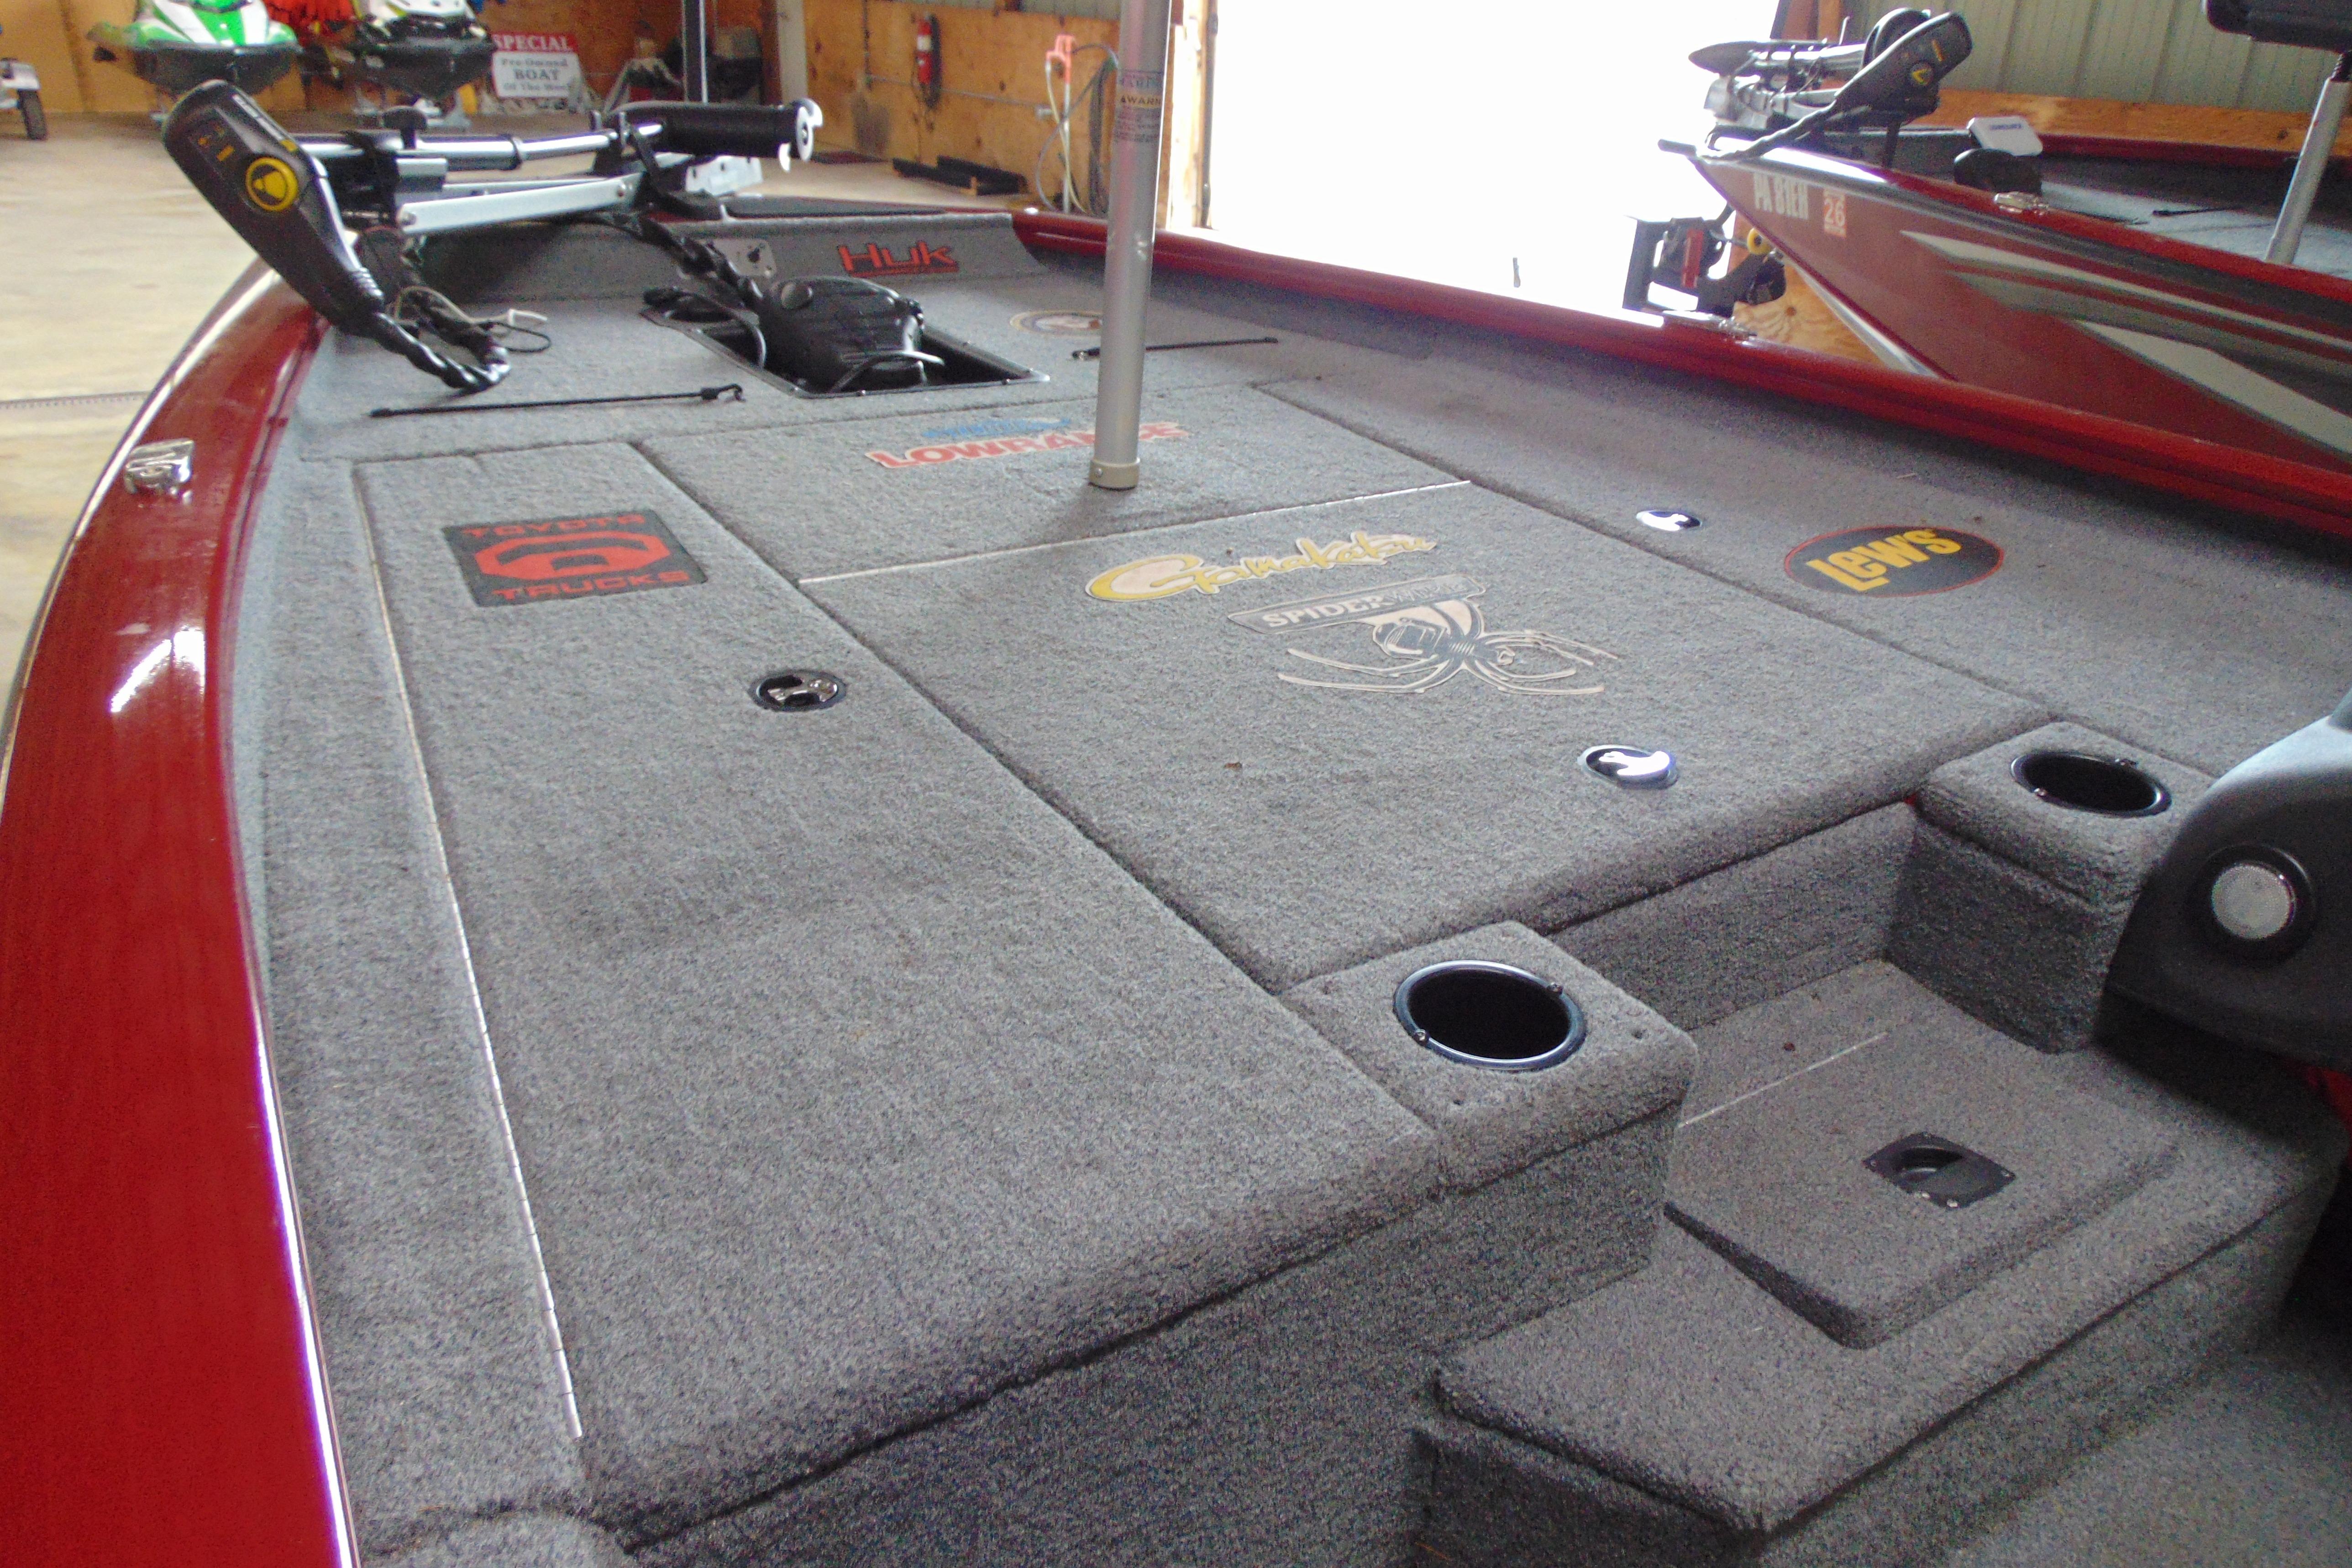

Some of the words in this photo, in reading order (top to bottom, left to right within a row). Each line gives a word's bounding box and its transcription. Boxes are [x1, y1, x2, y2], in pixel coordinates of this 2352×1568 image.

[493, 34, 573, 50] SPECIAL
[514, 68, 560, 80] BOAT
[1825, 197, 1845, 227] 26
[461, 514, 645, 538] TOYOTA
[493, 571, 689, 600] TRUCKS
